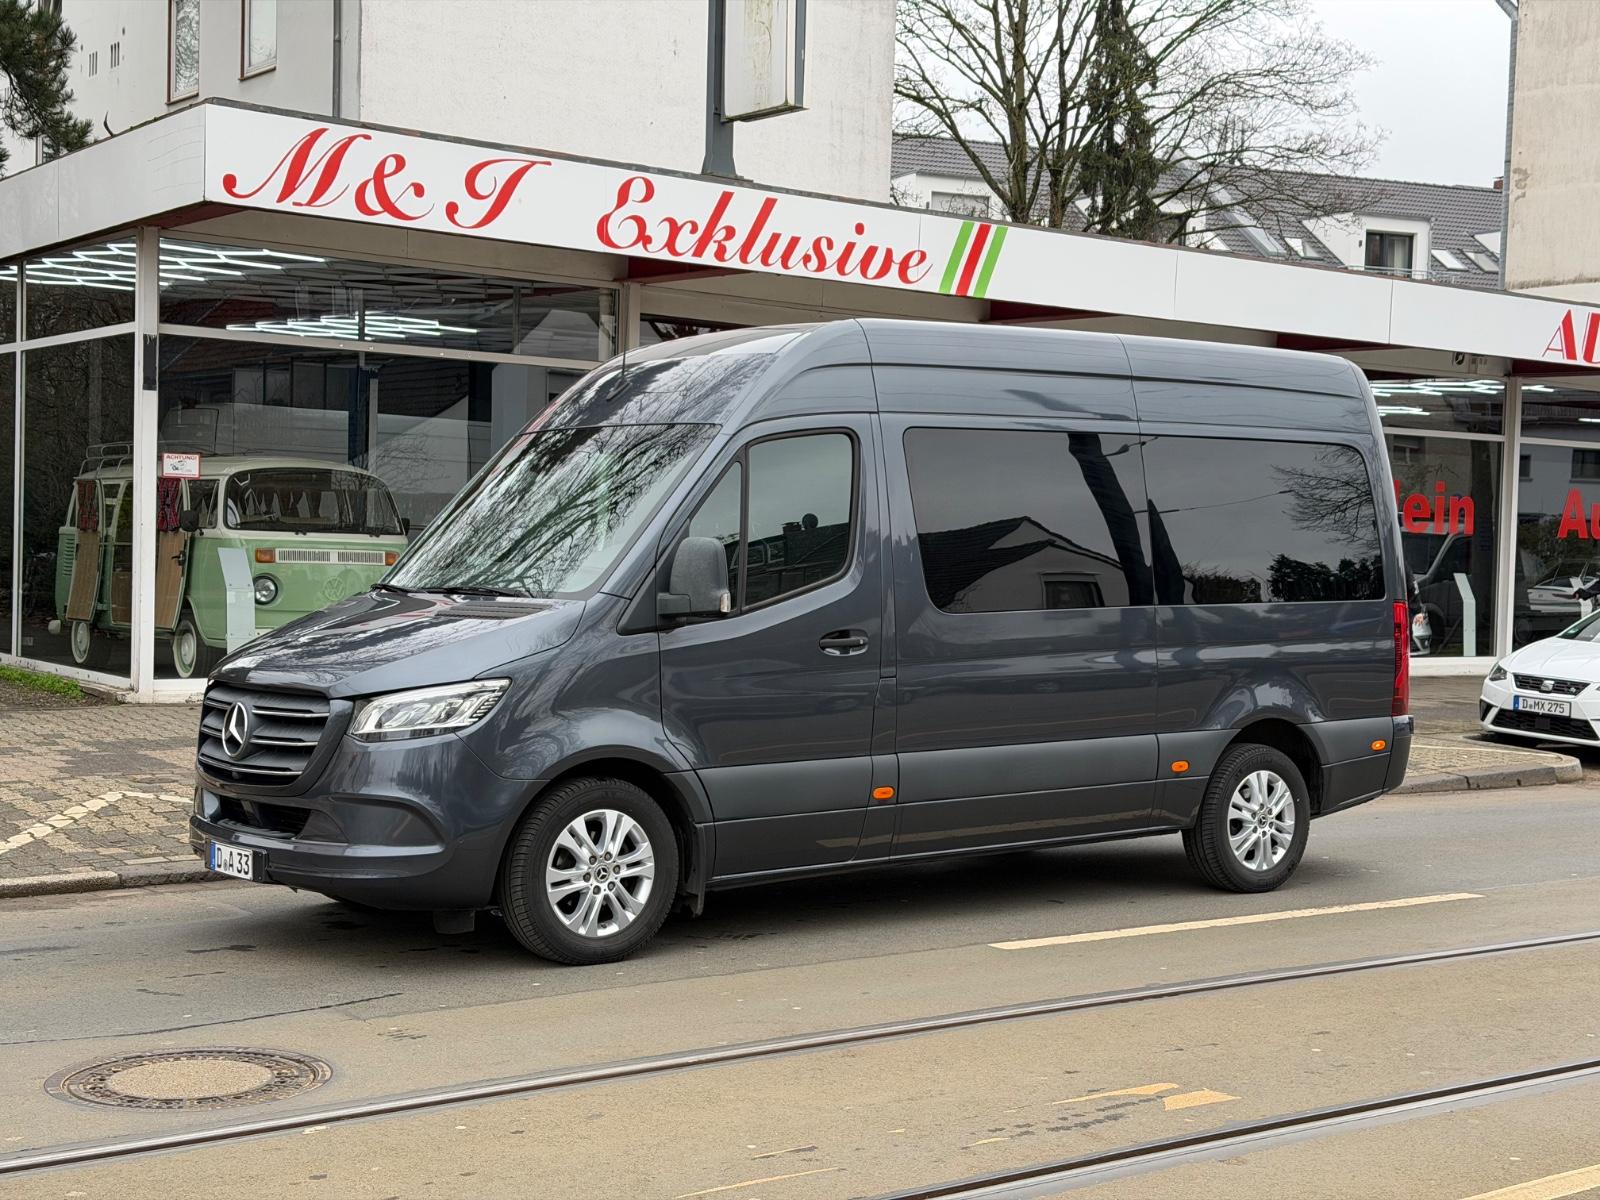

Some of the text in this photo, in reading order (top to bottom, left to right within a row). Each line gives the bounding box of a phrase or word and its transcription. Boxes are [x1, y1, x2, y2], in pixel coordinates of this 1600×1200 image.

[595, 175, 934, 286] Exklusive
[1522, 699, 1565, 713] D MX 275
[217, 847, 249, 875] D A 33
